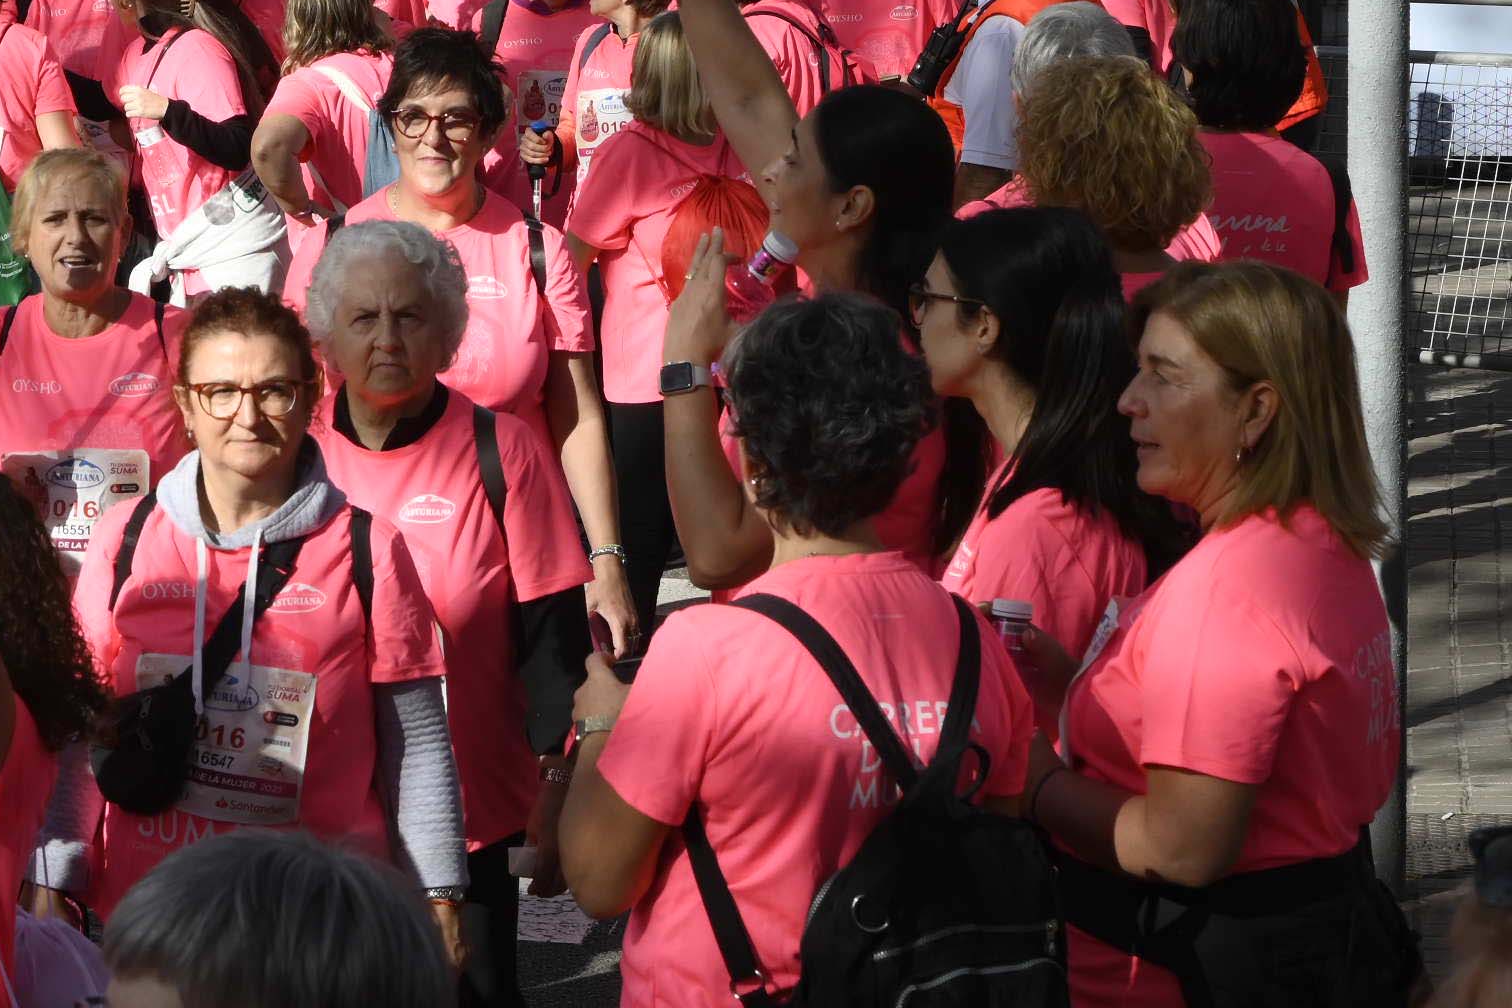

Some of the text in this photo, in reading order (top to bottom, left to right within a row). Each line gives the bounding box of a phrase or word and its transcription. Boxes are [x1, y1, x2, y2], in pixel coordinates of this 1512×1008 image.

[827, 14, 863, 24] OYSHO
[503, 38, 543, 49] OYSHO
[12, 378, 62, 394] OYSHO
[110, 467, 138, 475] SUMA
[53, 499, 99, 519] 016
[58, 541, 83, 549] DE LA
[142, 583, 196, 600] OYSH
[267, 691, 300, 703] SUMA
[209, 772, 220, 783] LA
[221, 775, 256, 791] MUJER
[230, 799, 285, 815] Santander
[139, 810, 216, 843] SUM
